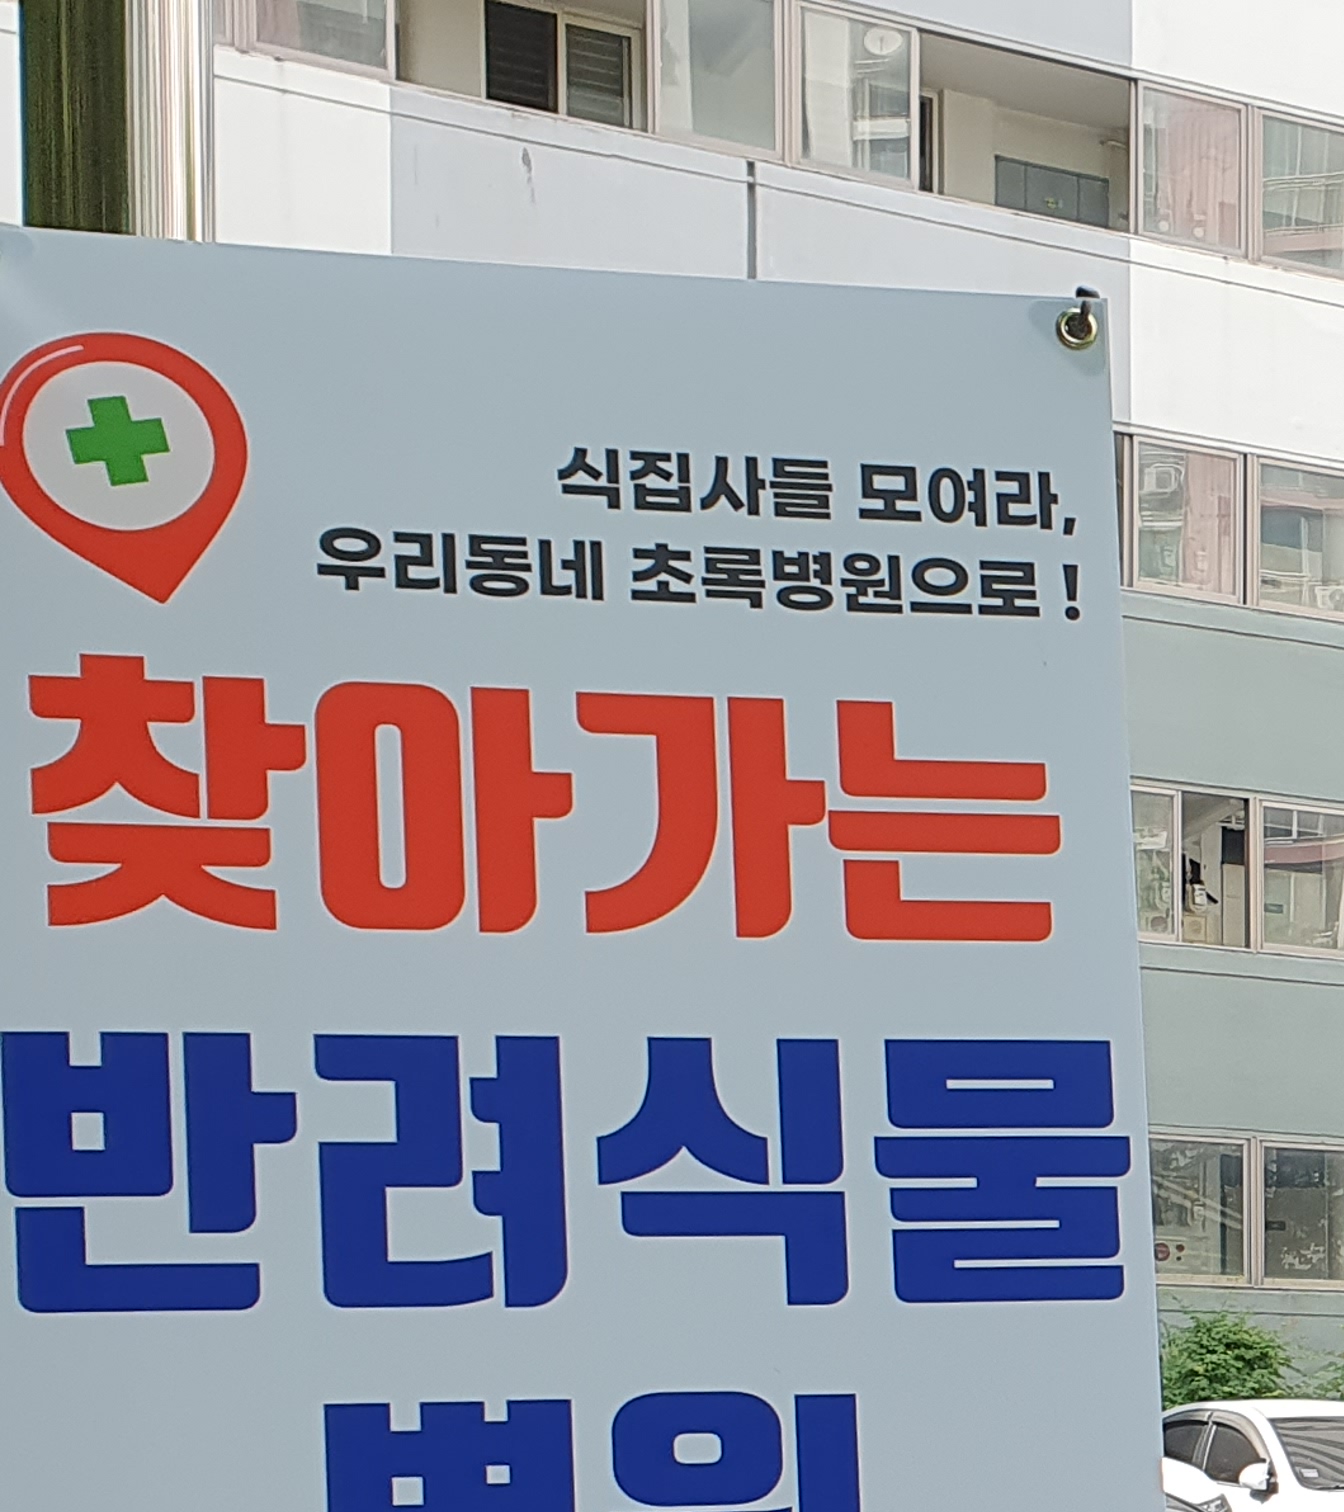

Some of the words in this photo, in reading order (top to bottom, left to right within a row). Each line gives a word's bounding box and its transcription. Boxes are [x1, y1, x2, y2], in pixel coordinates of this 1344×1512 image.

[316, 527, 604, 601] 우리동네
[557, 446, 833, 520] 식집사들
[858, 463, 1076, 536] 모여라,
[29, 654, 1061, 942] 찾아가는
[0, 1031, 1129, 1313] 반려식물
